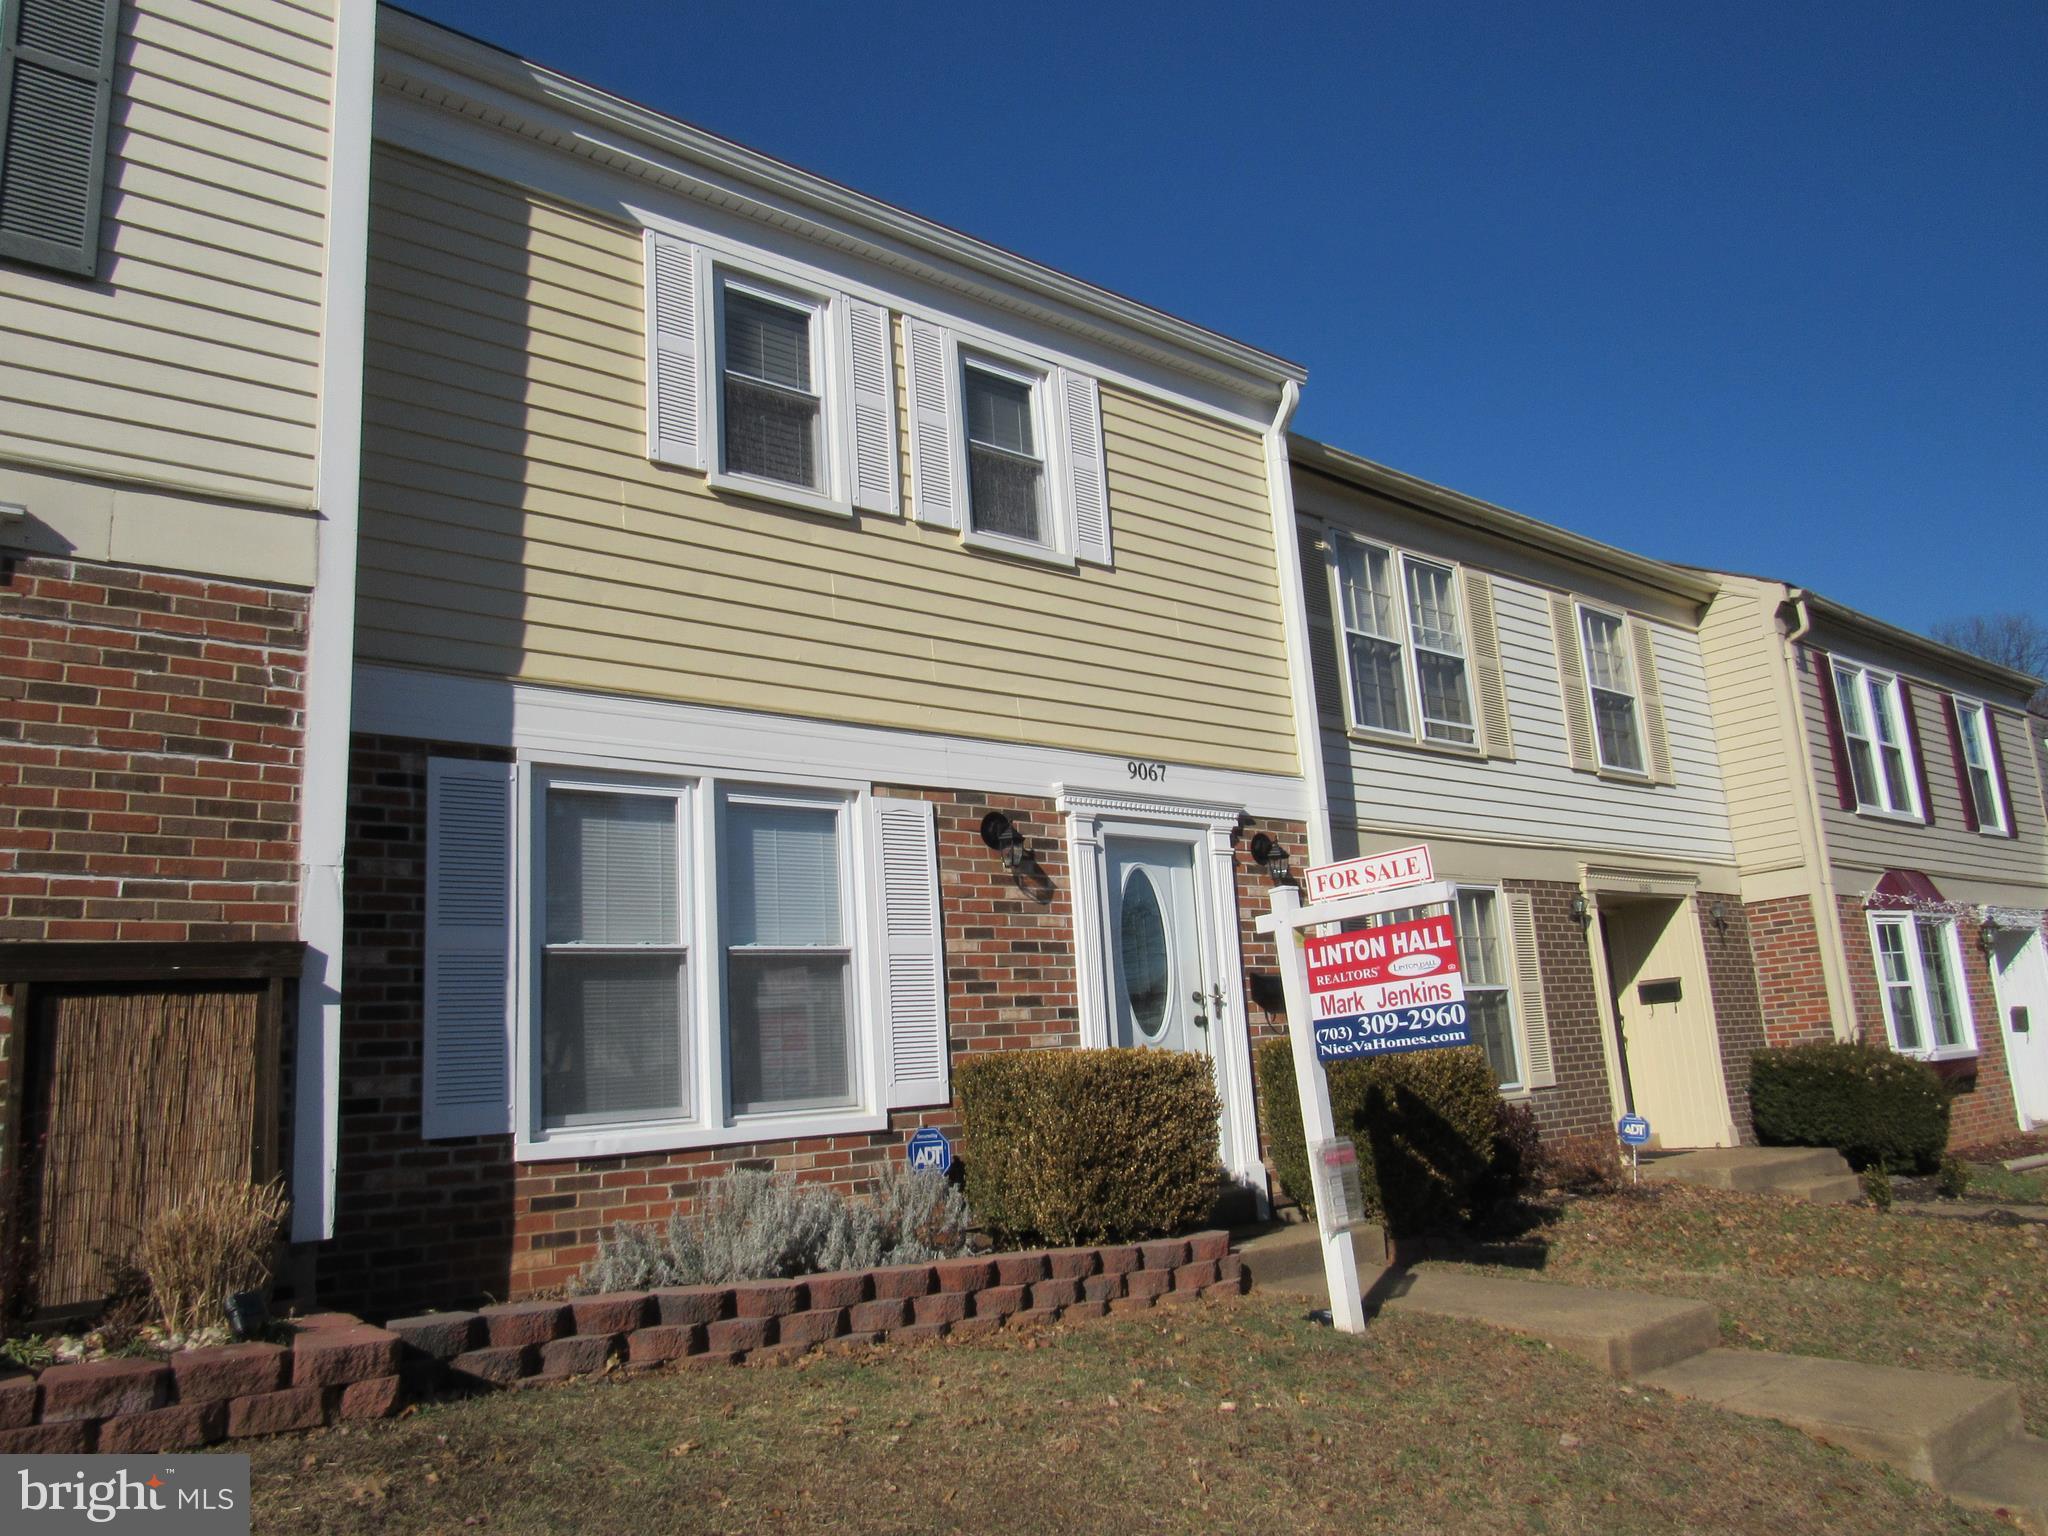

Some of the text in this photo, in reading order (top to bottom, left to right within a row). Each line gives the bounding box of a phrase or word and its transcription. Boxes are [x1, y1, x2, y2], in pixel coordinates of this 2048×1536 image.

[1128, 761, 1166, 782] 9067
[1316, 869, 1360, 893] FOR
[1364, 856, 1421, 883] SALE
[1307, 925, 1452, 969] LINTON HALL
[1320, 981, 1452, 1017] Mark Jenkins
[1316, 1003, 1466, 1045] (703) 309-2960
[1320, 1031, 1466, 1056] NiceVaHomes.com
[1624, 1123, 1645, 1136] ADT
[914, 1146, 944, 1170] ADT
